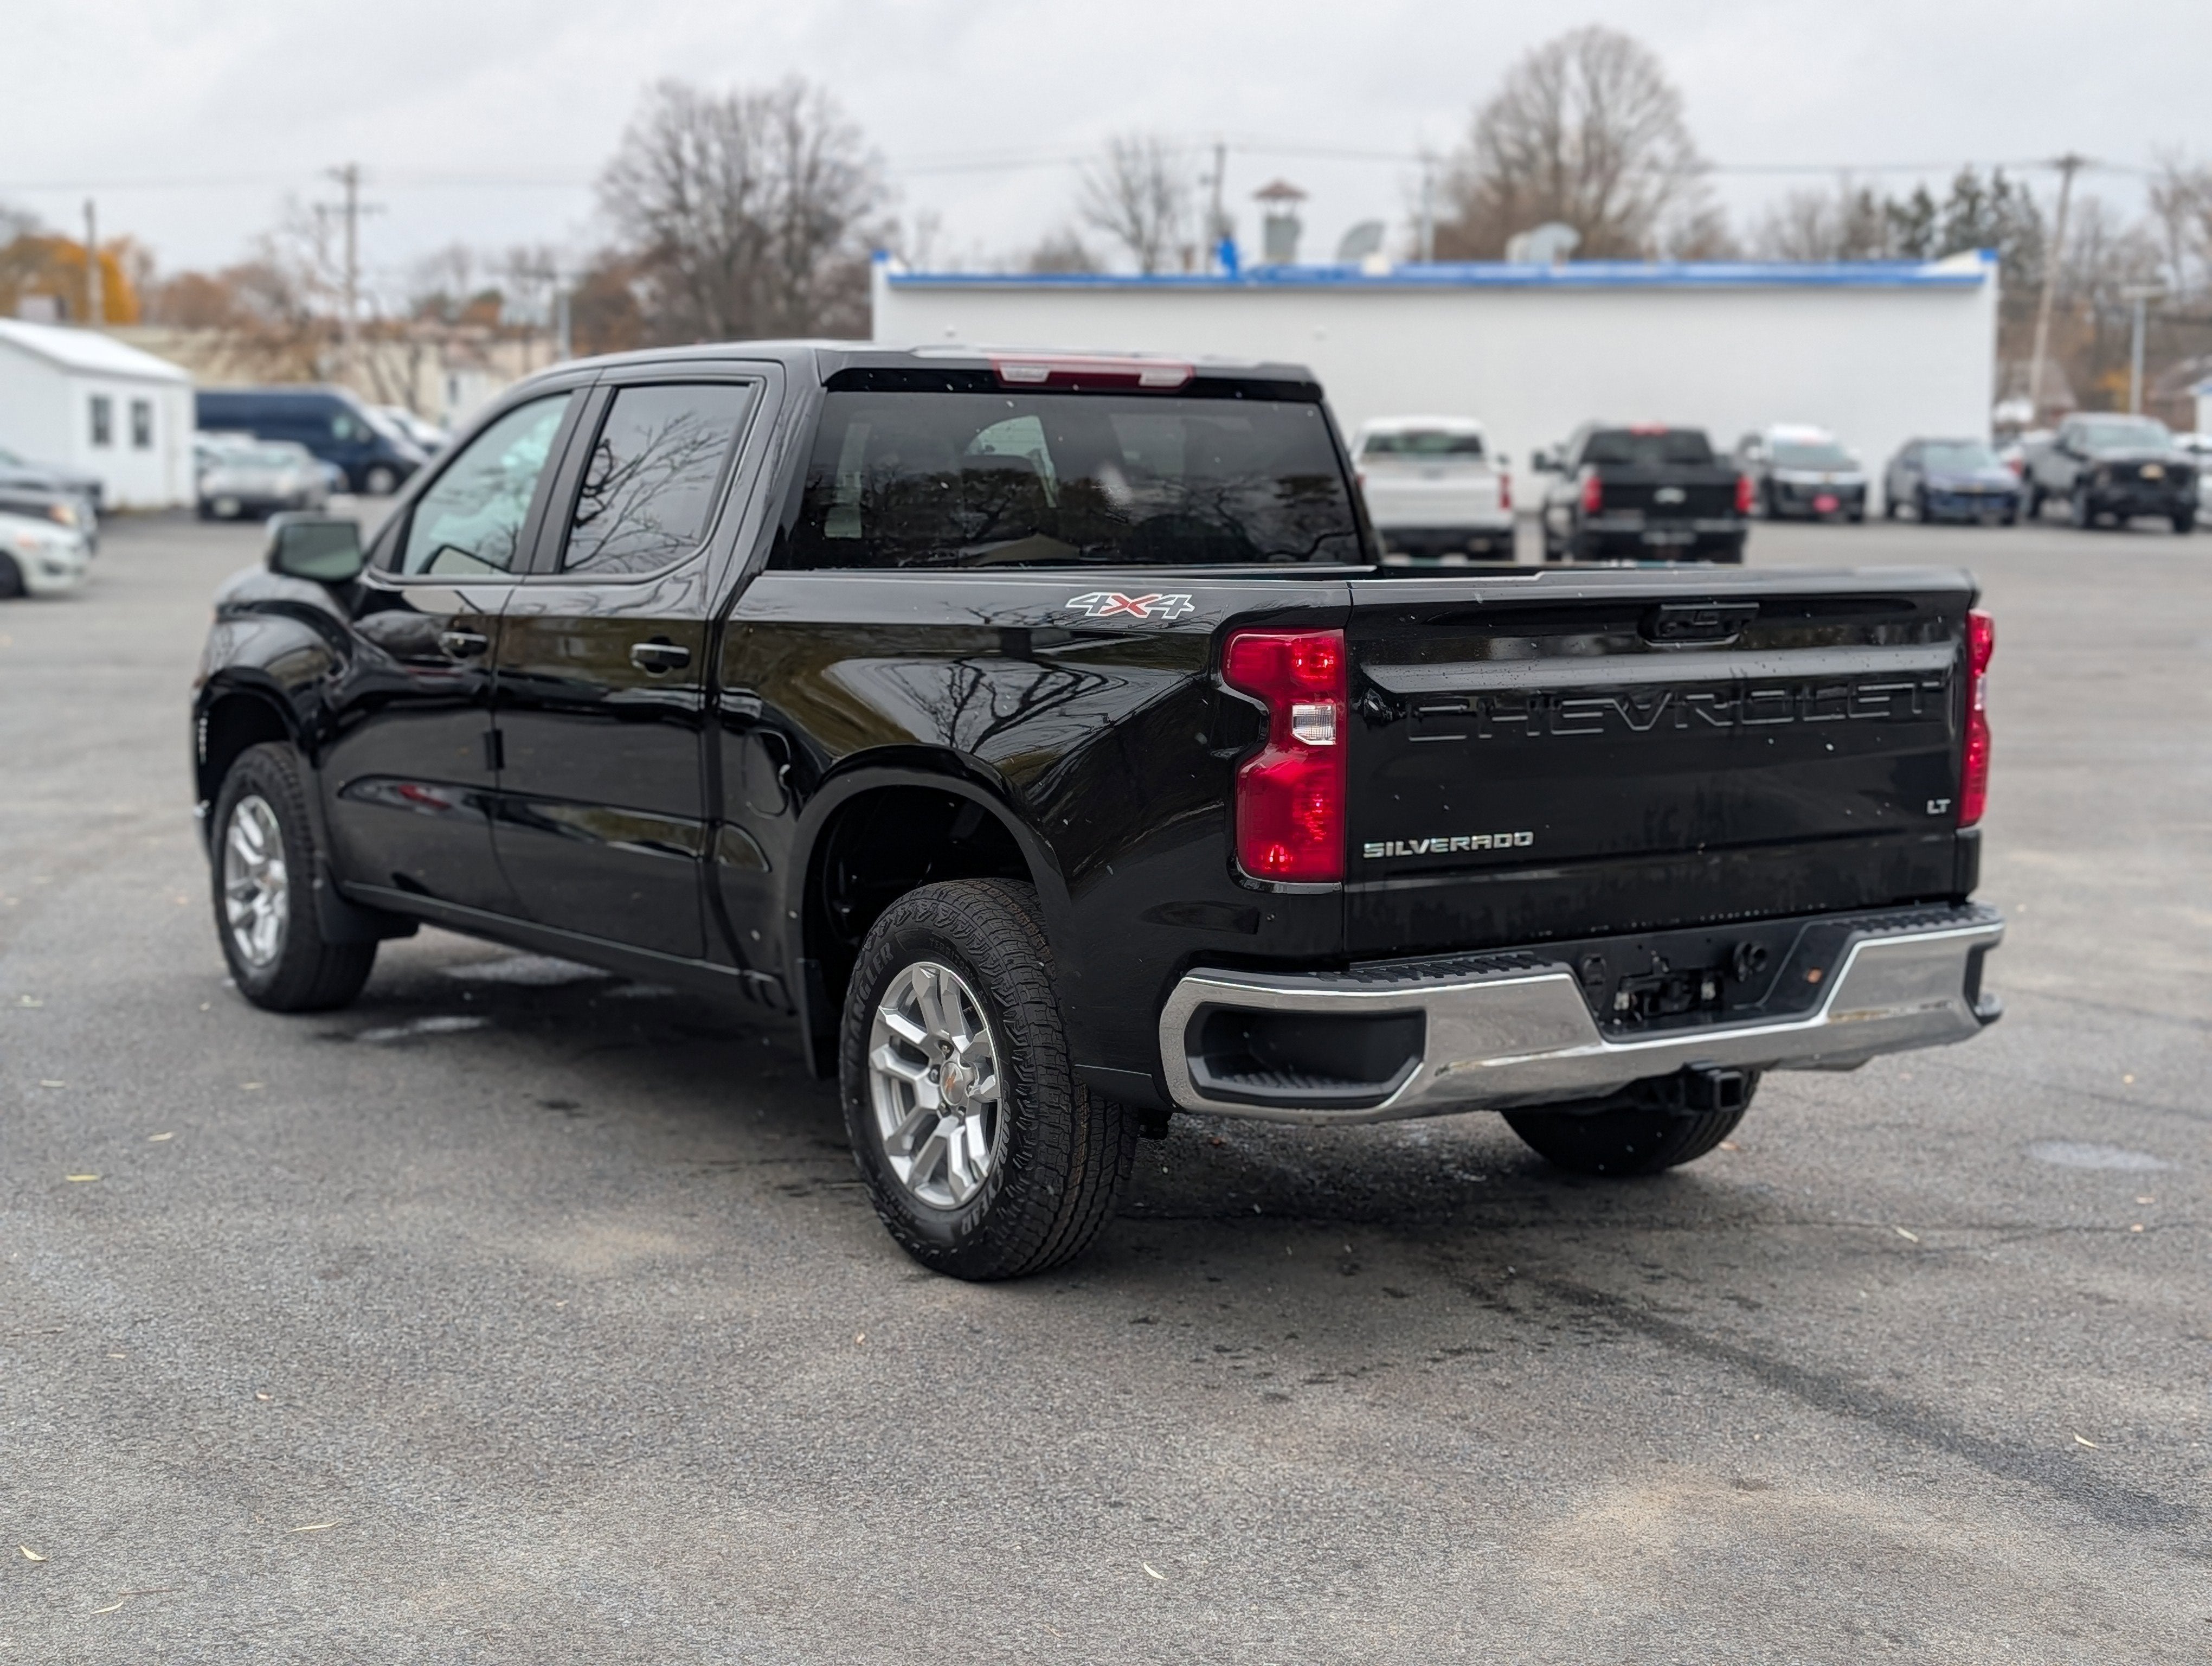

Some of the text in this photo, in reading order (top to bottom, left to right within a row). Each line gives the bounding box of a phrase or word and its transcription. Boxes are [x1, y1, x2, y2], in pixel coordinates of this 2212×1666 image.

[1409, 680, 1946, 742] CHEVROLET
[1926, 798, 1951, 815] LT
[1362, 831, 1534, 858] SILVERADO
